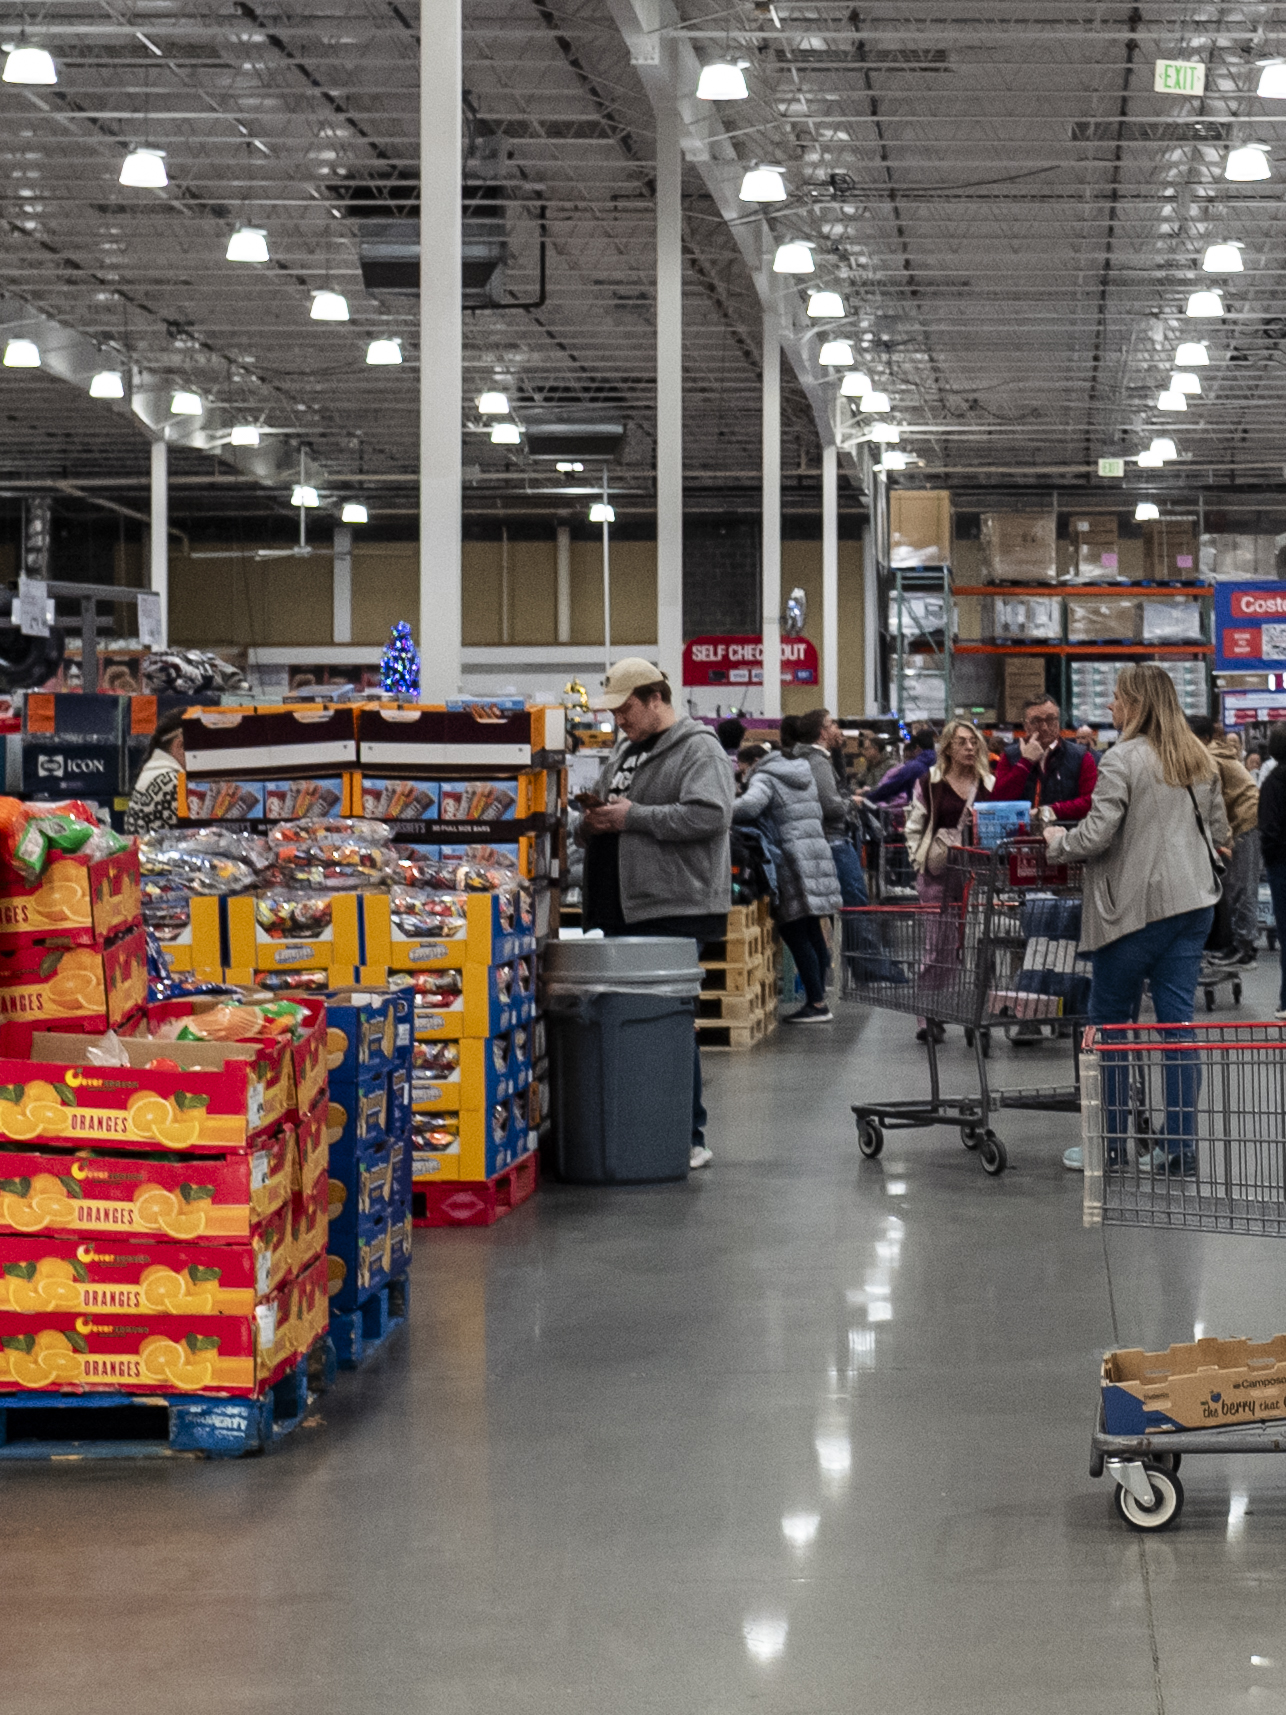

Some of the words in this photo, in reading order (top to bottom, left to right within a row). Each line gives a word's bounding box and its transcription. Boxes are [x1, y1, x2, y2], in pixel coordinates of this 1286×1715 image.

[1164, 64, 1197, 90] EXIT
[692, 644, 725, 661] SELF
[67, 759, 104, 773] ICON
[71, 1114, 128, 1134] ORANGES
[78, 1206, 134, 1225] ORANGES
[84, 1290, 140, 1308] ORANGES
[84, 1360, 140, 1377] ORANGES
[1203, 1405, 1219, 1418] the
[1221, 1399, 1256, 1416] berry
[1259, 1399, 1281, 1411] that
